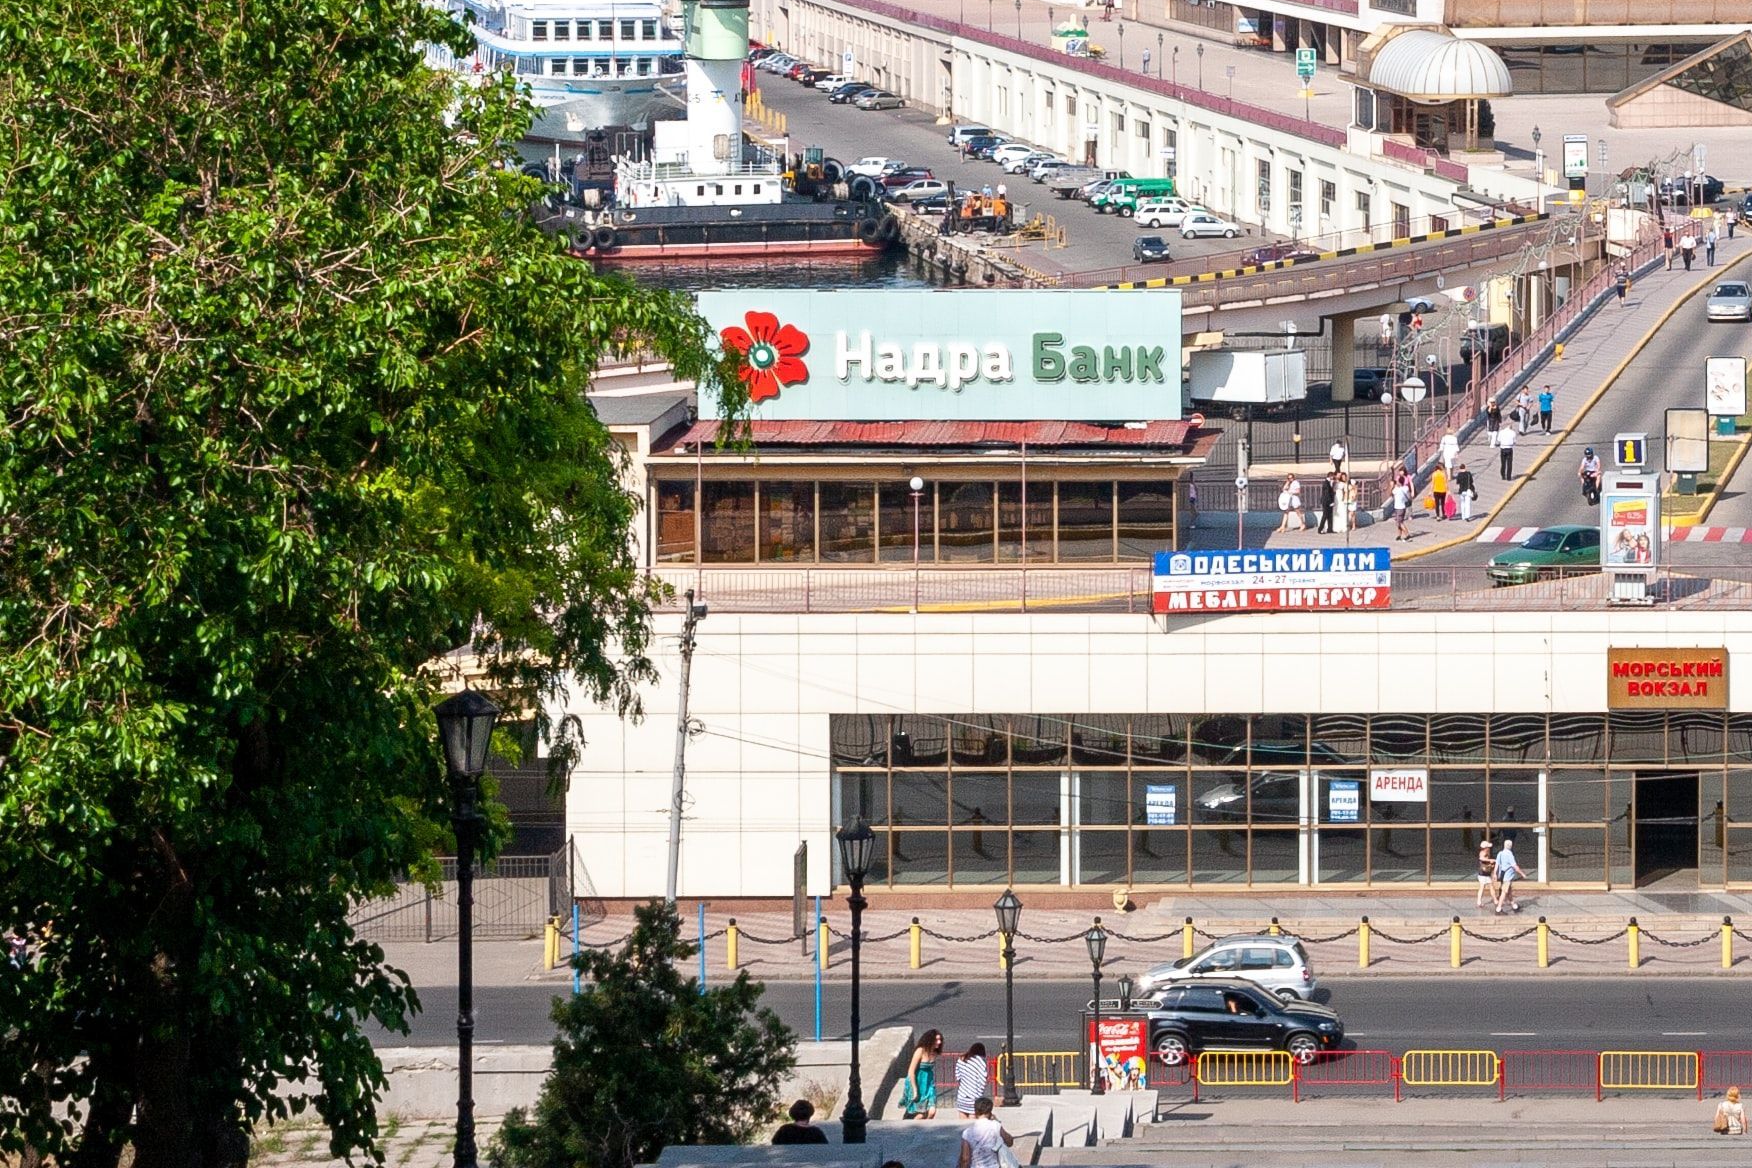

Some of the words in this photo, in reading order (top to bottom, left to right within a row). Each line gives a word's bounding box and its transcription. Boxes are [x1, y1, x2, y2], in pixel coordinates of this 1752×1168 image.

[835, 331, 1012, 392] Надра
[1032, 332, 1164, 383] Банк
[1194, 550, 1324, 575] ОДЕСЬКИЙ
[1330, 552, 1376, 573] ДІМ
[1252, 575, 1265, 585] 24
[1275, 574, 1287, 584] 27
[1168, 590, 1249, 609] МЕБЛІ
[1612, 658, 1724, 678] МОРСЬКИЙ
[1627, 681, 1709, 698] ВОКЗАЛ
[1375, 775, 1423, 792] АРЕНДА
